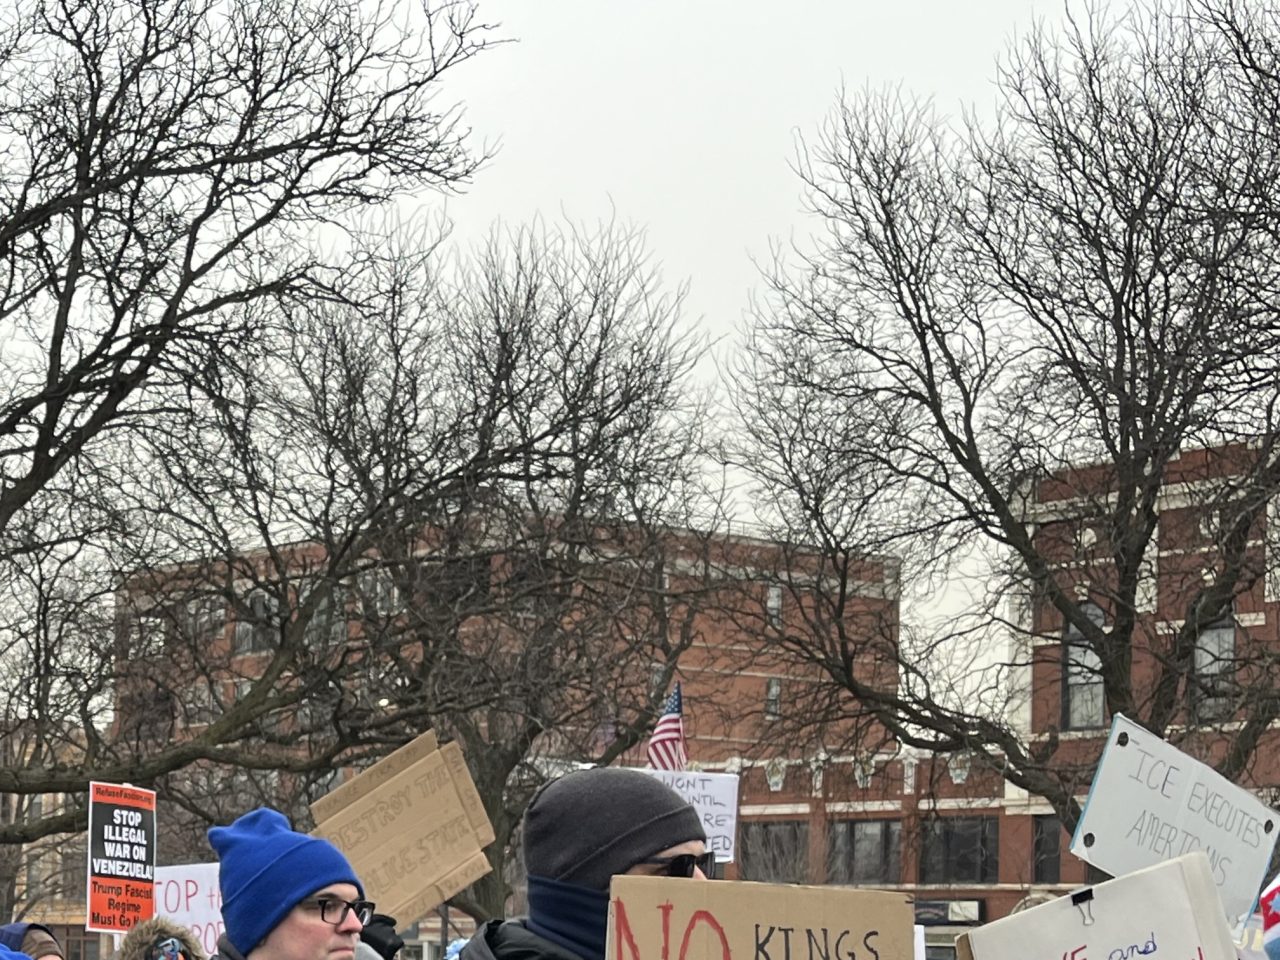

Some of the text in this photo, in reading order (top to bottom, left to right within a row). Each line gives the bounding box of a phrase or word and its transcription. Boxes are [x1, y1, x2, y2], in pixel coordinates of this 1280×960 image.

[1128, 749, 1266, 848] ICE EXECUTES
[112, 809, 142, 827] STOP
[103, 825, 147, 845] ILLEGAL
[104, 842, 146, 862] WAR ON
[92, 858, 153, 880] VENEZUELA!
[92, 881, 153, 899] Trump Fascist
[154, 880, 199, 914] TOP
[107, 898, 141, 914] Regime
[91, 912, 116, 926] Must
[119, 914, 131, 927] Go
